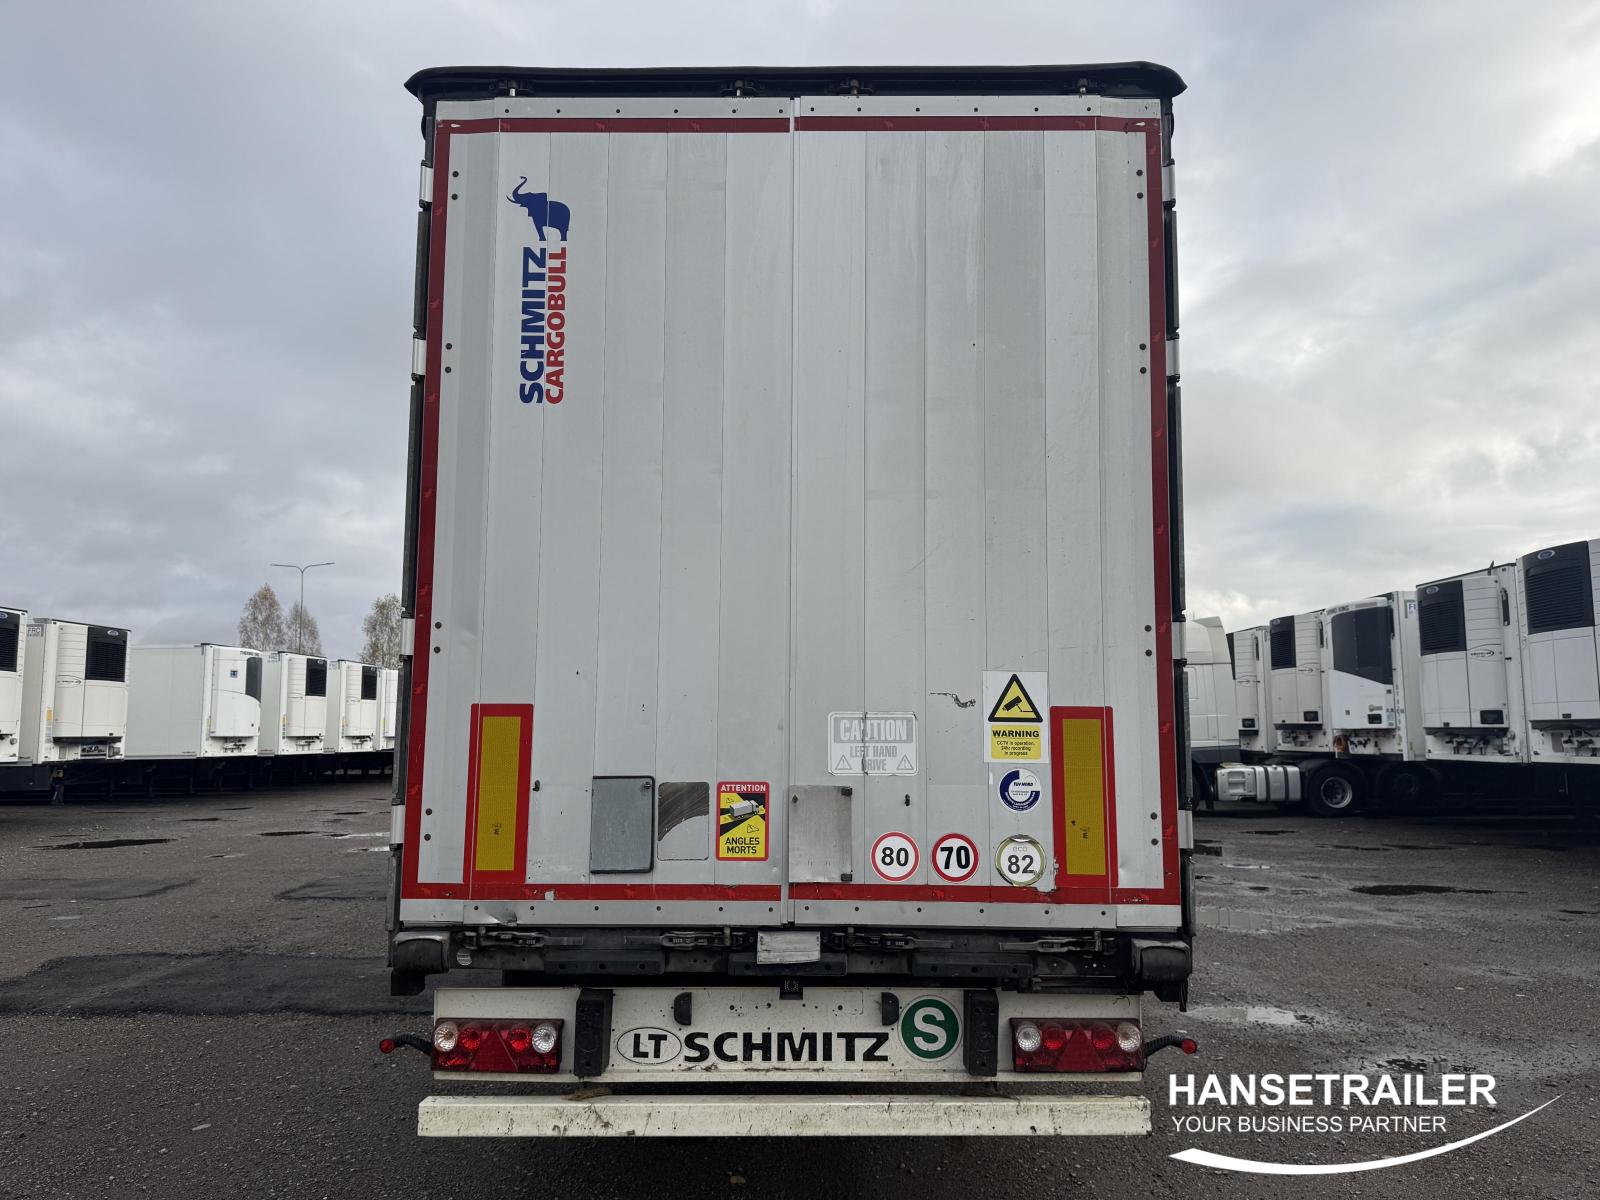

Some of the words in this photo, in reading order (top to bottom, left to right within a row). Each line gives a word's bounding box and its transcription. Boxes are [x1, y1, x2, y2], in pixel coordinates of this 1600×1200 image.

[519, 247, 547, 404] SCHMITZ
[544, 247, 567, 405] CARGOBULL
[840, 719, 907, 741] CAUTION
[992, 729, 1040, 738] WARNING
[850, 745, 871, 758] LEFT
[872, 745, 898, 758] HAND
[720, 784, 766, 792] ATTENTION
[725, 837, 760, 845] ANGLES
[726, 846, 757, 854] MORTS
[881, 846, 910, 867] 80
[940, 846, 971, 870] 70
[1007, 854, 1035, 874] 82
[913, 1006, 947, 1051] S
[633, 1033, 668, 1059] LT
[684, 1031, 890, 1062] SCHMITZ
